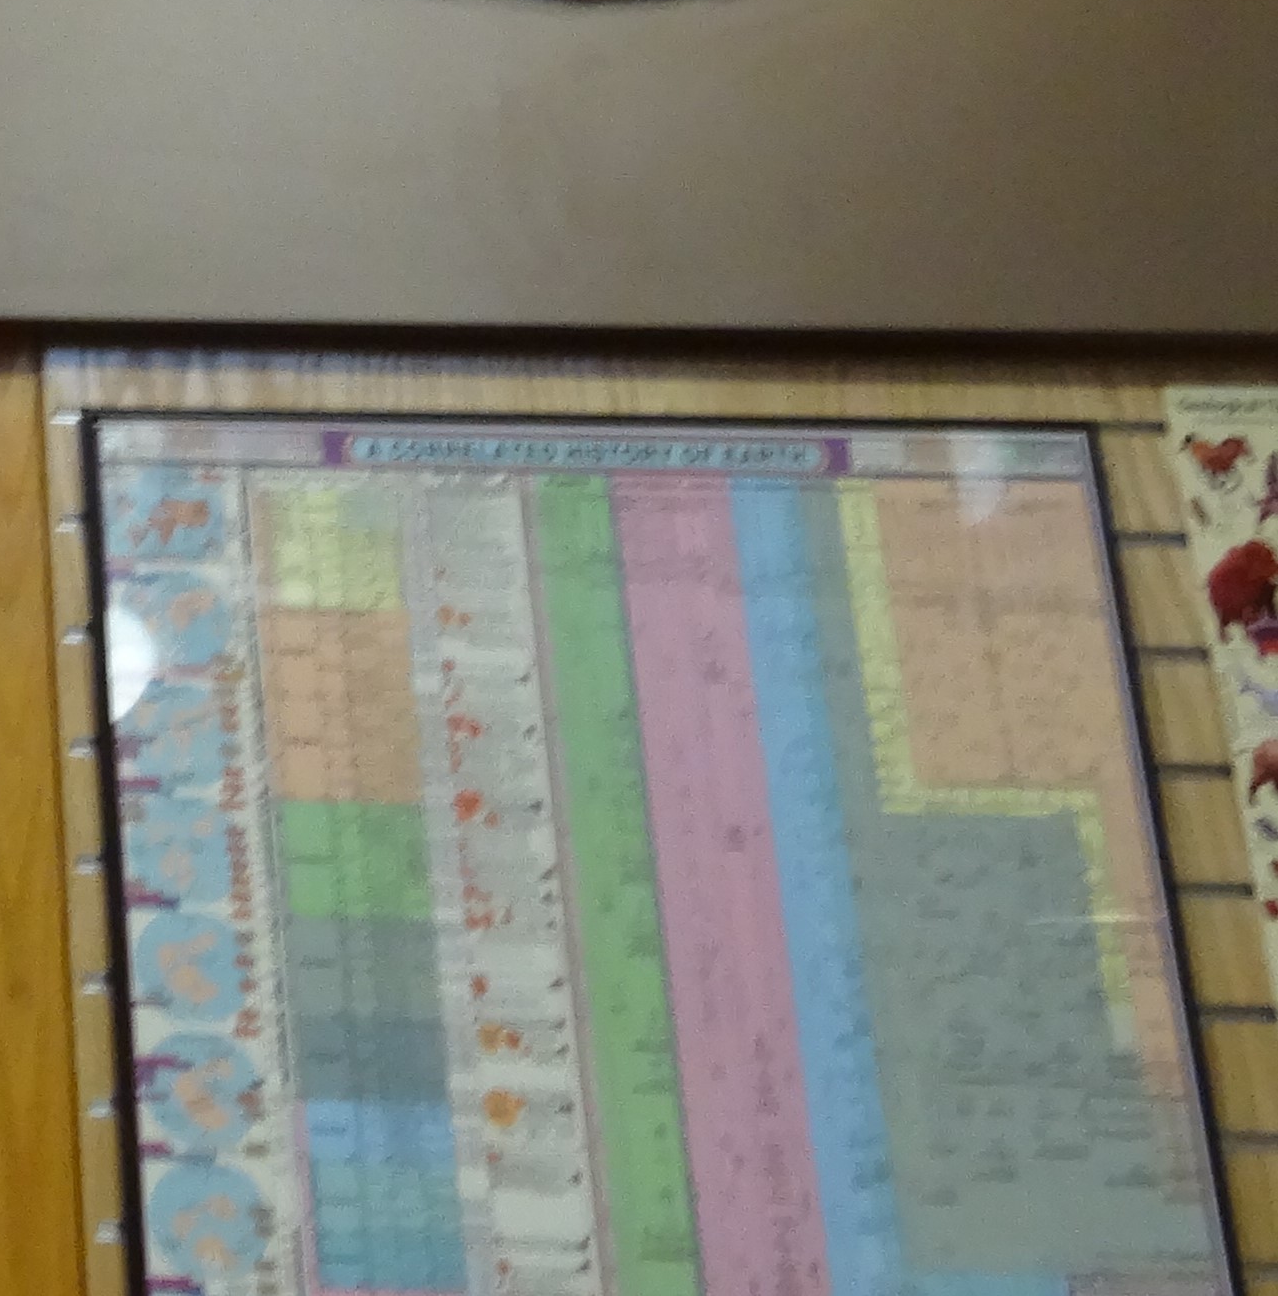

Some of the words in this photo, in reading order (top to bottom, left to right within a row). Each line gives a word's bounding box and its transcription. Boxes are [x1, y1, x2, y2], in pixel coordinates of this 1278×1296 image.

[365, 438, 381, 460] A
[389, 437, 558, 463] CORRELATED
[564, 440, 674, 465] HISTORY
[679, 442, 710, 465] OF
[722, 443, 805, 467] EARTH
